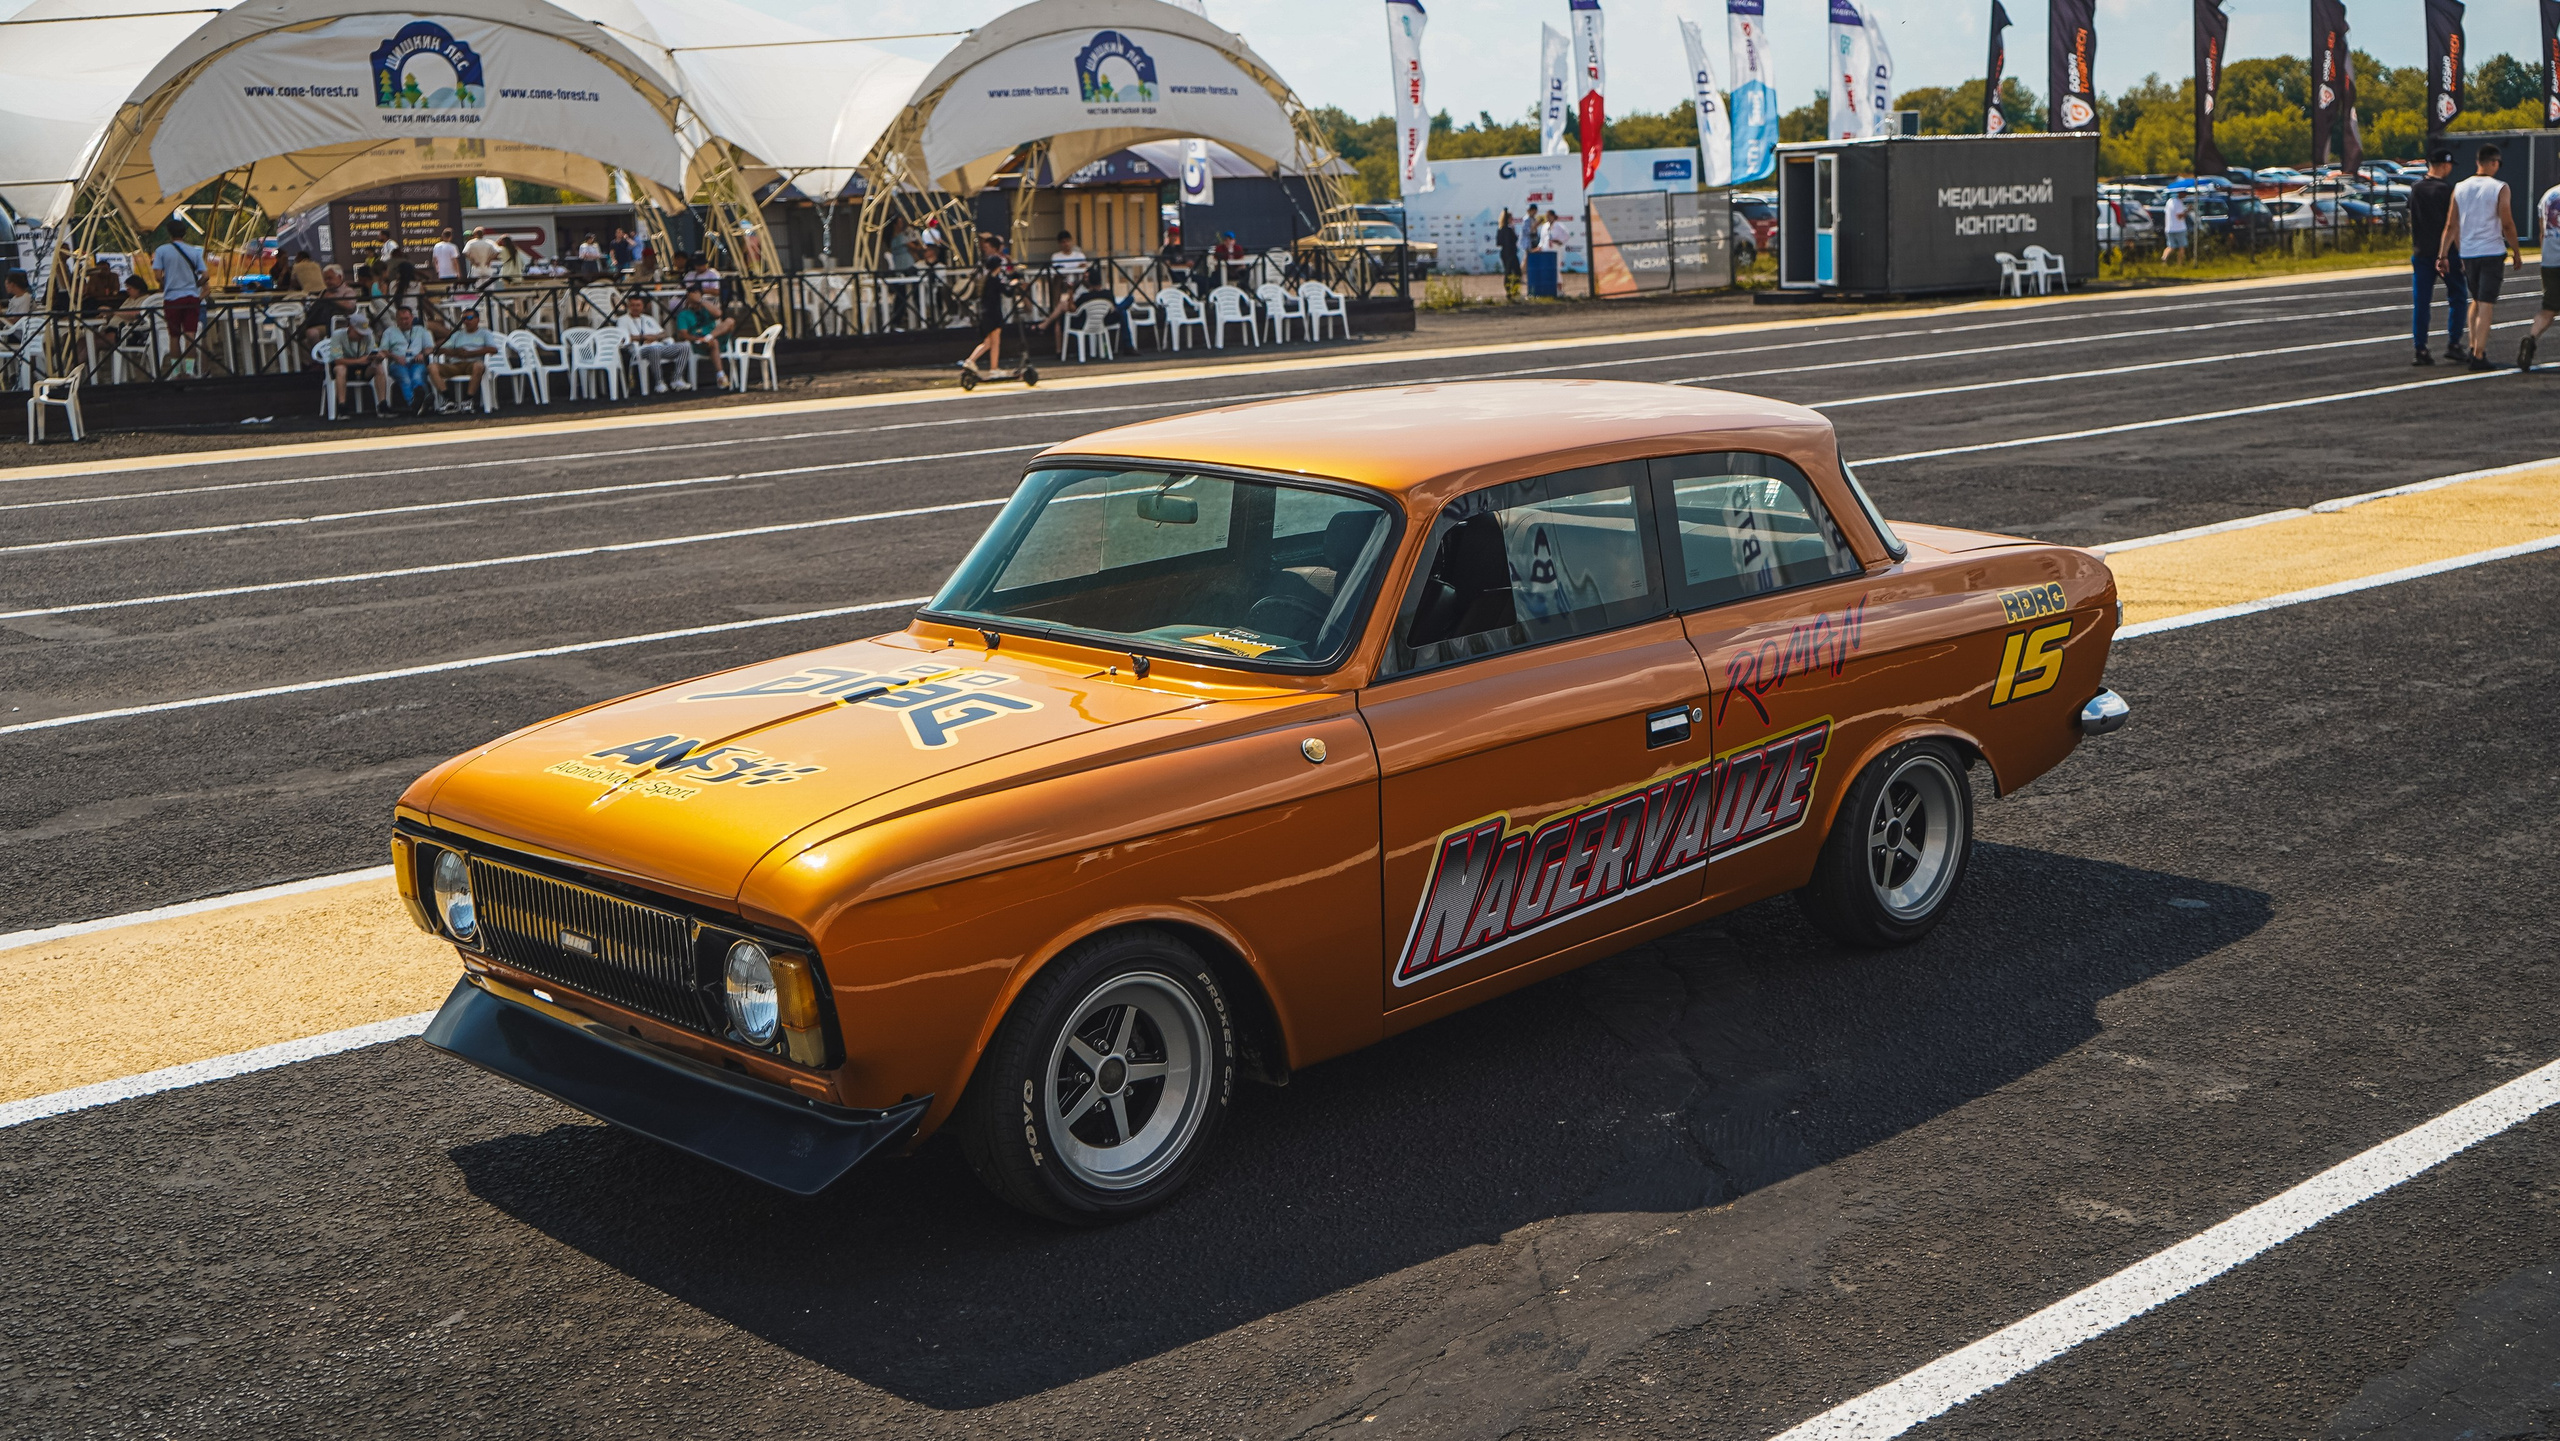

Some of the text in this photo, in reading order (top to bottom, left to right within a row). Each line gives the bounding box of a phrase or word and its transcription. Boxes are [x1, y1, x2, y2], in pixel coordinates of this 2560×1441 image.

[384, 34, 470, 71] ШИШКИН ЛЕС
[2066, 52, 2081, 94] GOSHA
[2076, 27, 2090, 94] TURBOTECH
[244, 85, 359, 98] www.cone-forest.ru
[499, 88, 599, 102] www.cone-forest.ru
[382, 114, 413, 123] ЧИСТАЯ
[459, 114, 481, 123] ВОДА
[1937, 177, 2054, 210] МЕДИЦИНСКИЙ
[1955, 213, 2038, 236] КОНТРОЛЬ
[1996, 581, 2068, 624] RDRC
[1716, 592, 1868, 728] ROMAN
[1989, 618, 2073, 710] 15
[555, 761, 601, 781] Alania
[646, 779, 698, 801] Sport
[1398, 720, 1830, 977] NAGERVADZE
[1197, 972, 1233, 1058] PROXES
[1022, 1079, 1044, 1167] TOYO
